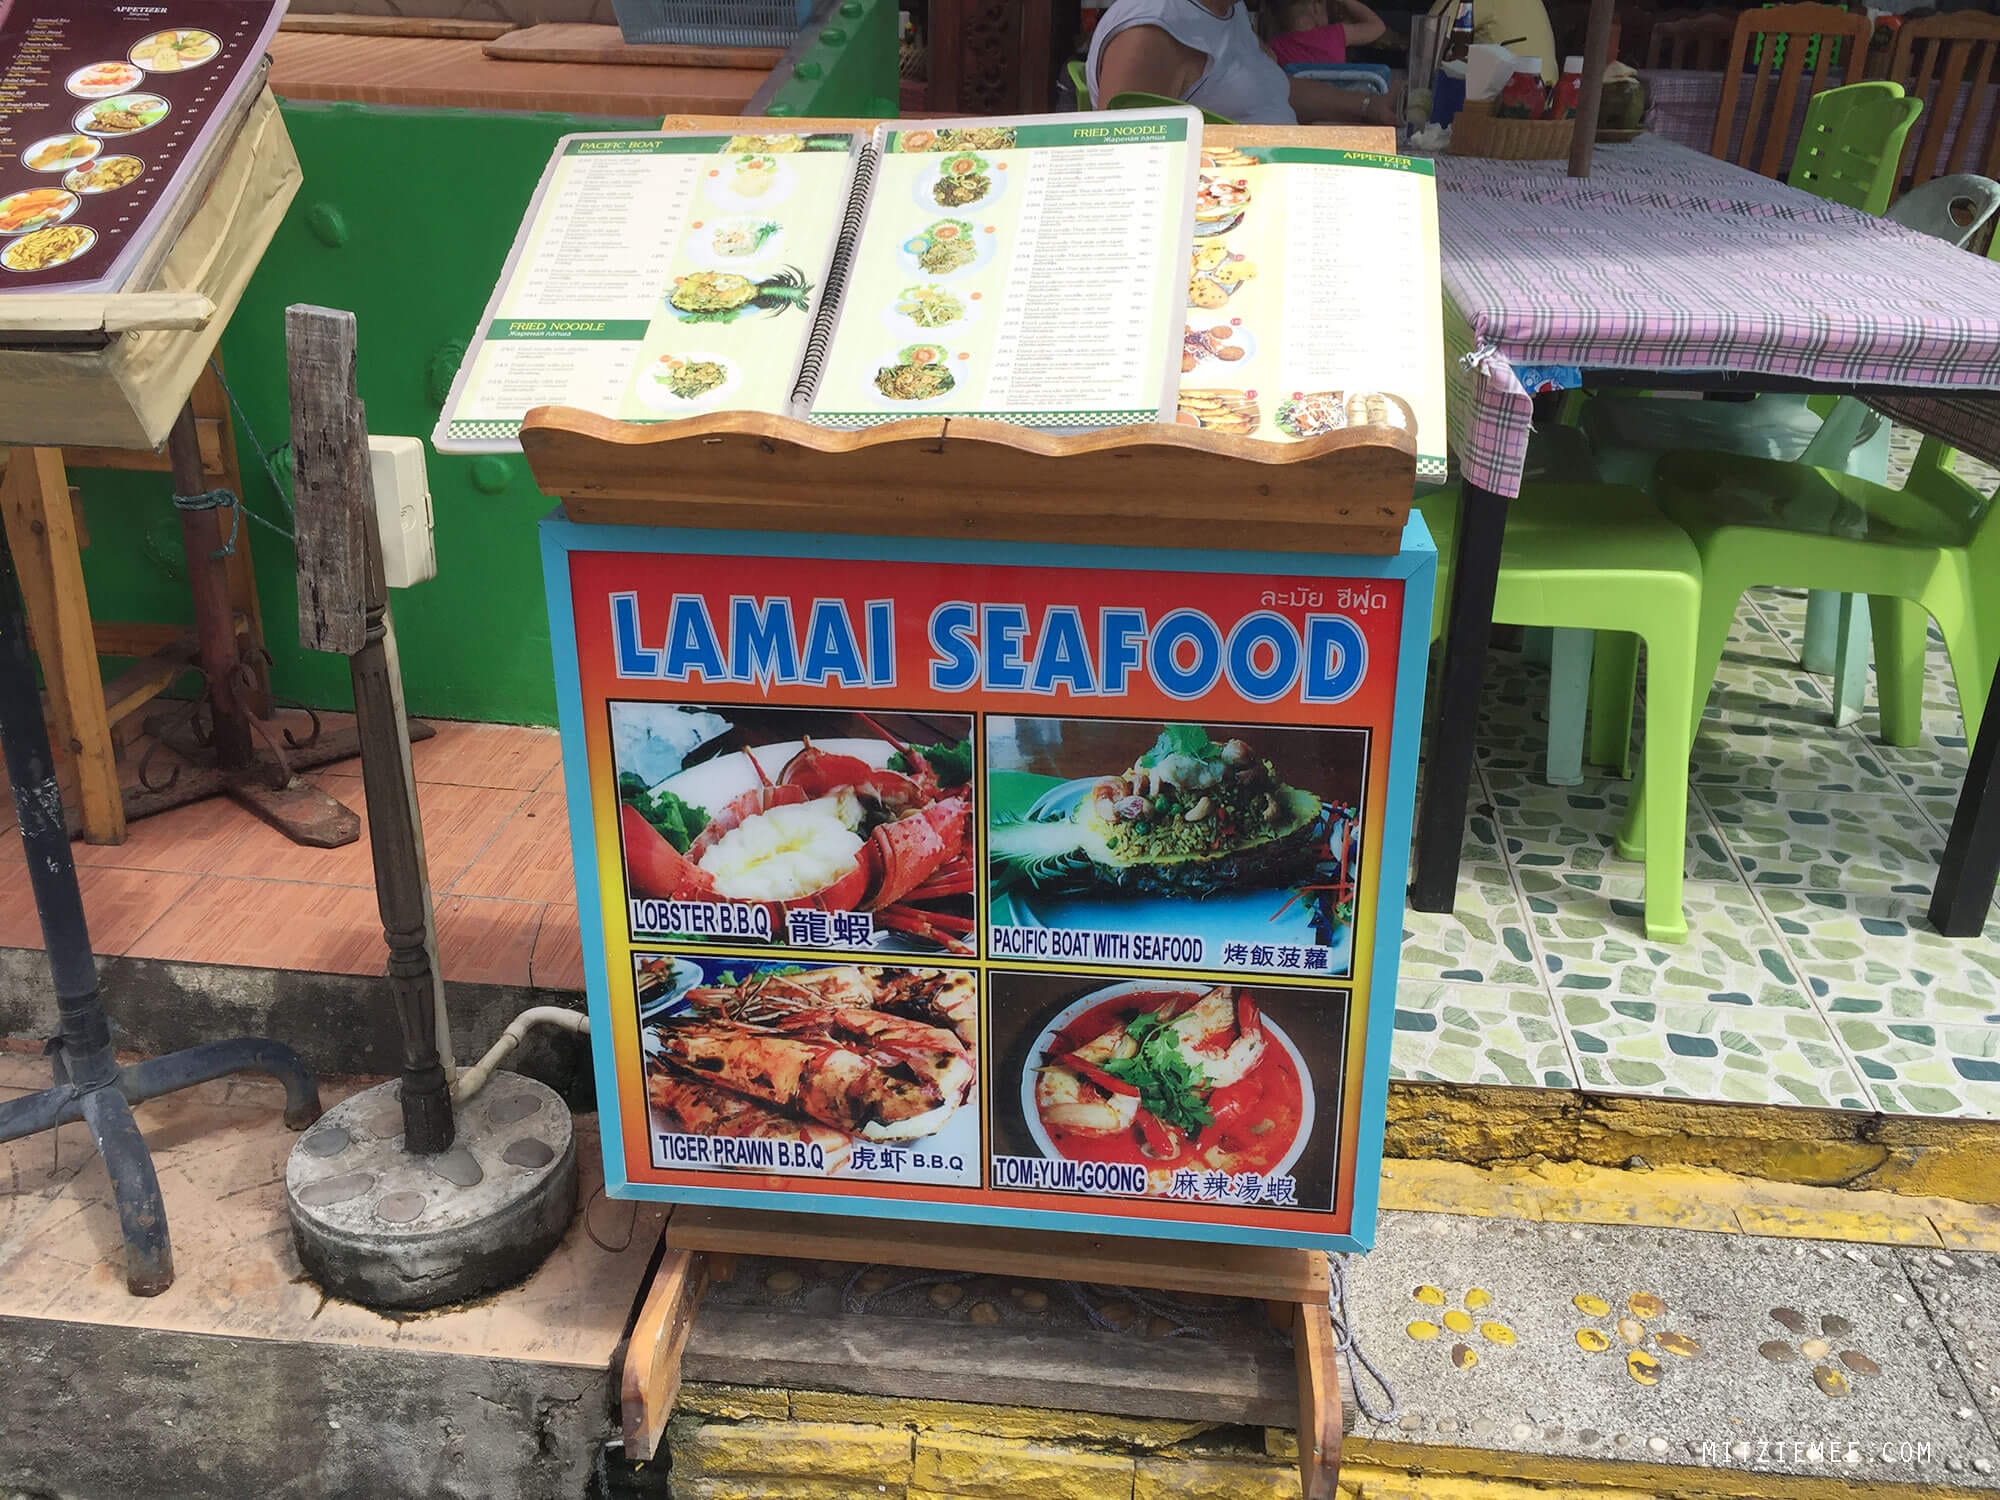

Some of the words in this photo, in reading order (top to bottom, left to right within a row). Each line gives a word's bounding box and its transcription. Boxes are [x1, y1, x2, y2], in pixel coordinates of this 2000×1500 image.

[113, 6, 168, 14] APPETIZER
[1073, 127, 1109, 137] FRIED
[1113, 125, 1167, 135] NOODLE
[580, 141, 626, 149] PACIFIC
[1343, 151, 1412, 167] APPETIZER
[509, 322, 545, 331] FRIED
[549, 322, 606, 331] NOODLE
[1260, 586, 1324, 608] ละมัย
[608, 590, 897, 698] LAMAI
[928, 600, 1369, 705] SEAFOOD
[633, 901, 716, 933] LOBSTER
[719, 905, 771, 937] B.B.Q
[788, 910, 873, 947] 龍蝦
[993, 926, 1049, 956] PACIFIC
[1051, 930, 1090, 958] BOAT
[1093, 932, 1130, 960] WITH
[1132, 934, 1203, 963] SEAFOOD
[658, 1134, 712, 1163] TIGER
[712, 1138, 774, 1167] PRAWN
[778, 1141, 824, 1170] B.B.Q
[912, 1153, 964, 1171] B.B.Q
[996, 1157, 1146, 1193] TOM-YUM-GOONG
